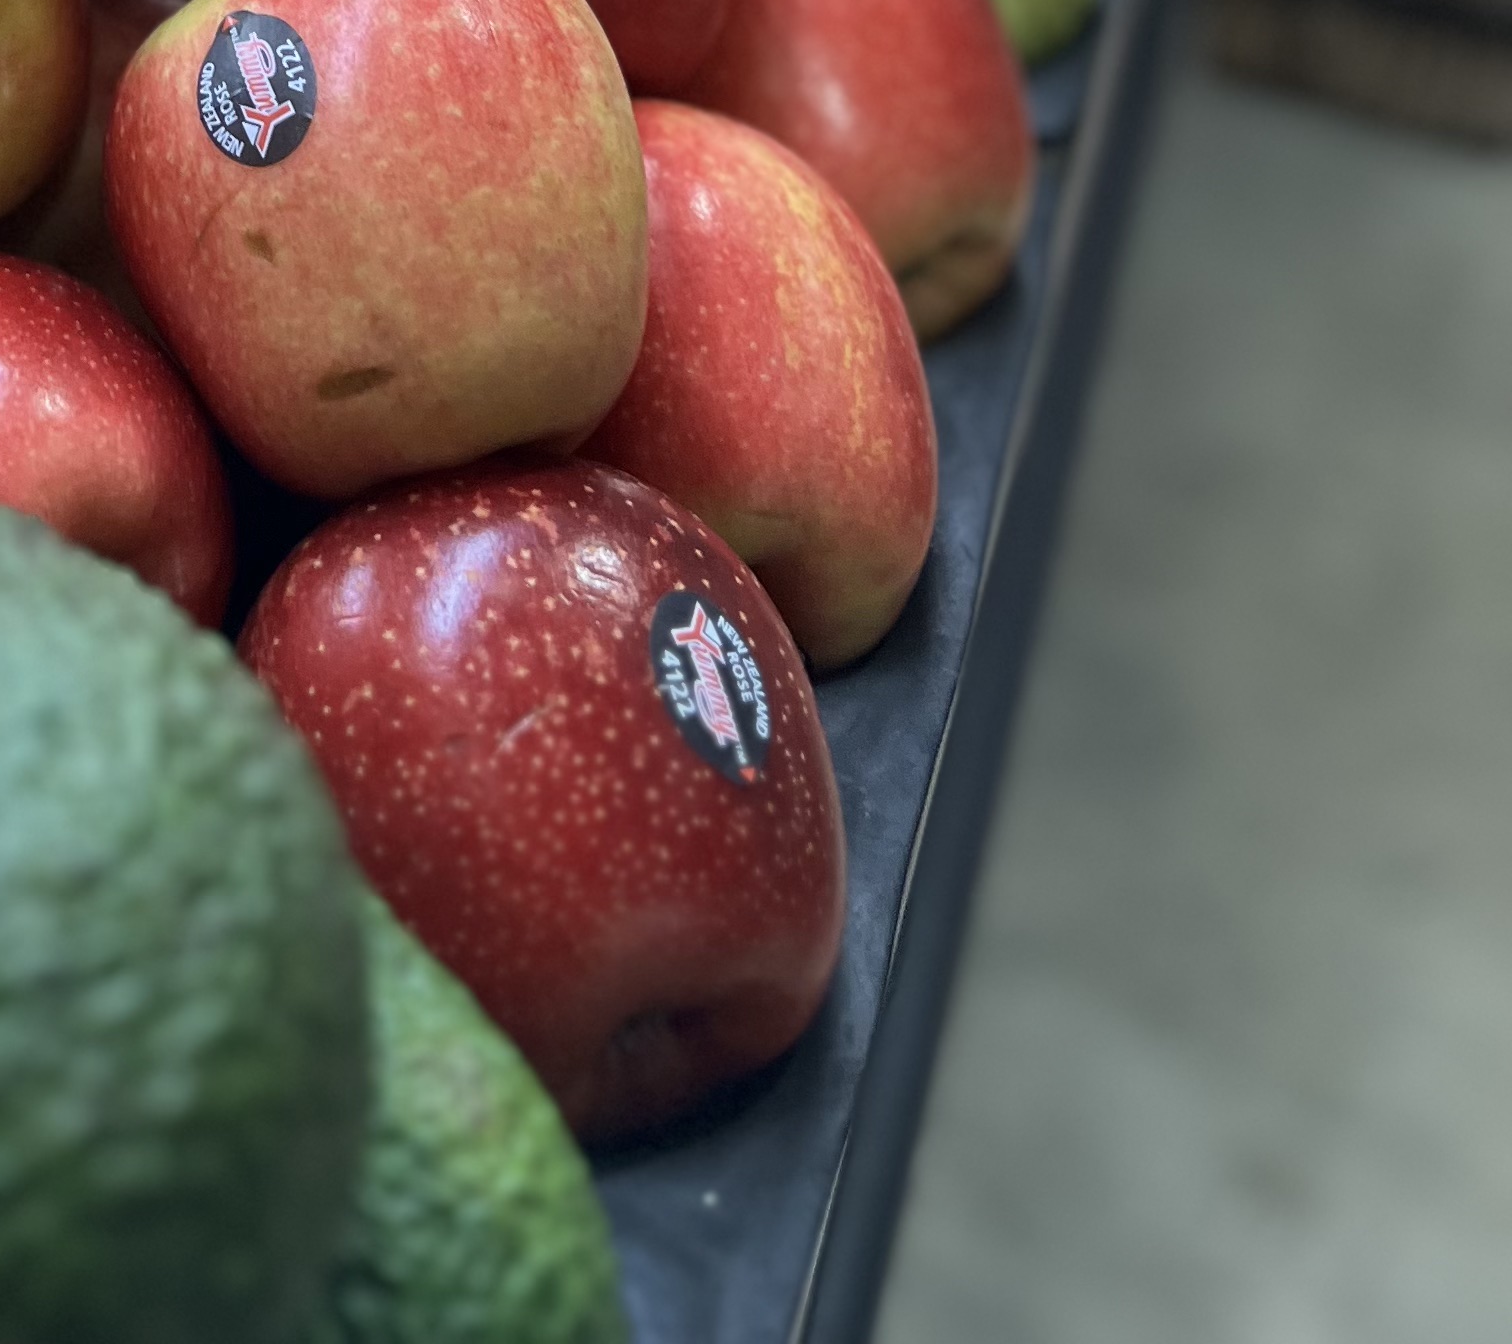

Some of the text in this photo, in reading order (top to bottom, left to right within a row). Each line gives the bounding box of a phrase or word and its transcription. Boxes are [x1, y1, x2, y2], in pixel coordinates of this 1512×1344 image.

[213, 80, 238, 126] ROSE
[235, 31, 296, 159] Yummy
[275, 38, 307, 94] 4122
[200, 62, 244, 158] NEW ZEALAND
[661, 649, 696, 718] 4122
[670, 599, 739, 748] Yummy
[717, 615, 769, 739] NEW ZEALAND
[726, 650, 755, 703] ROSE
